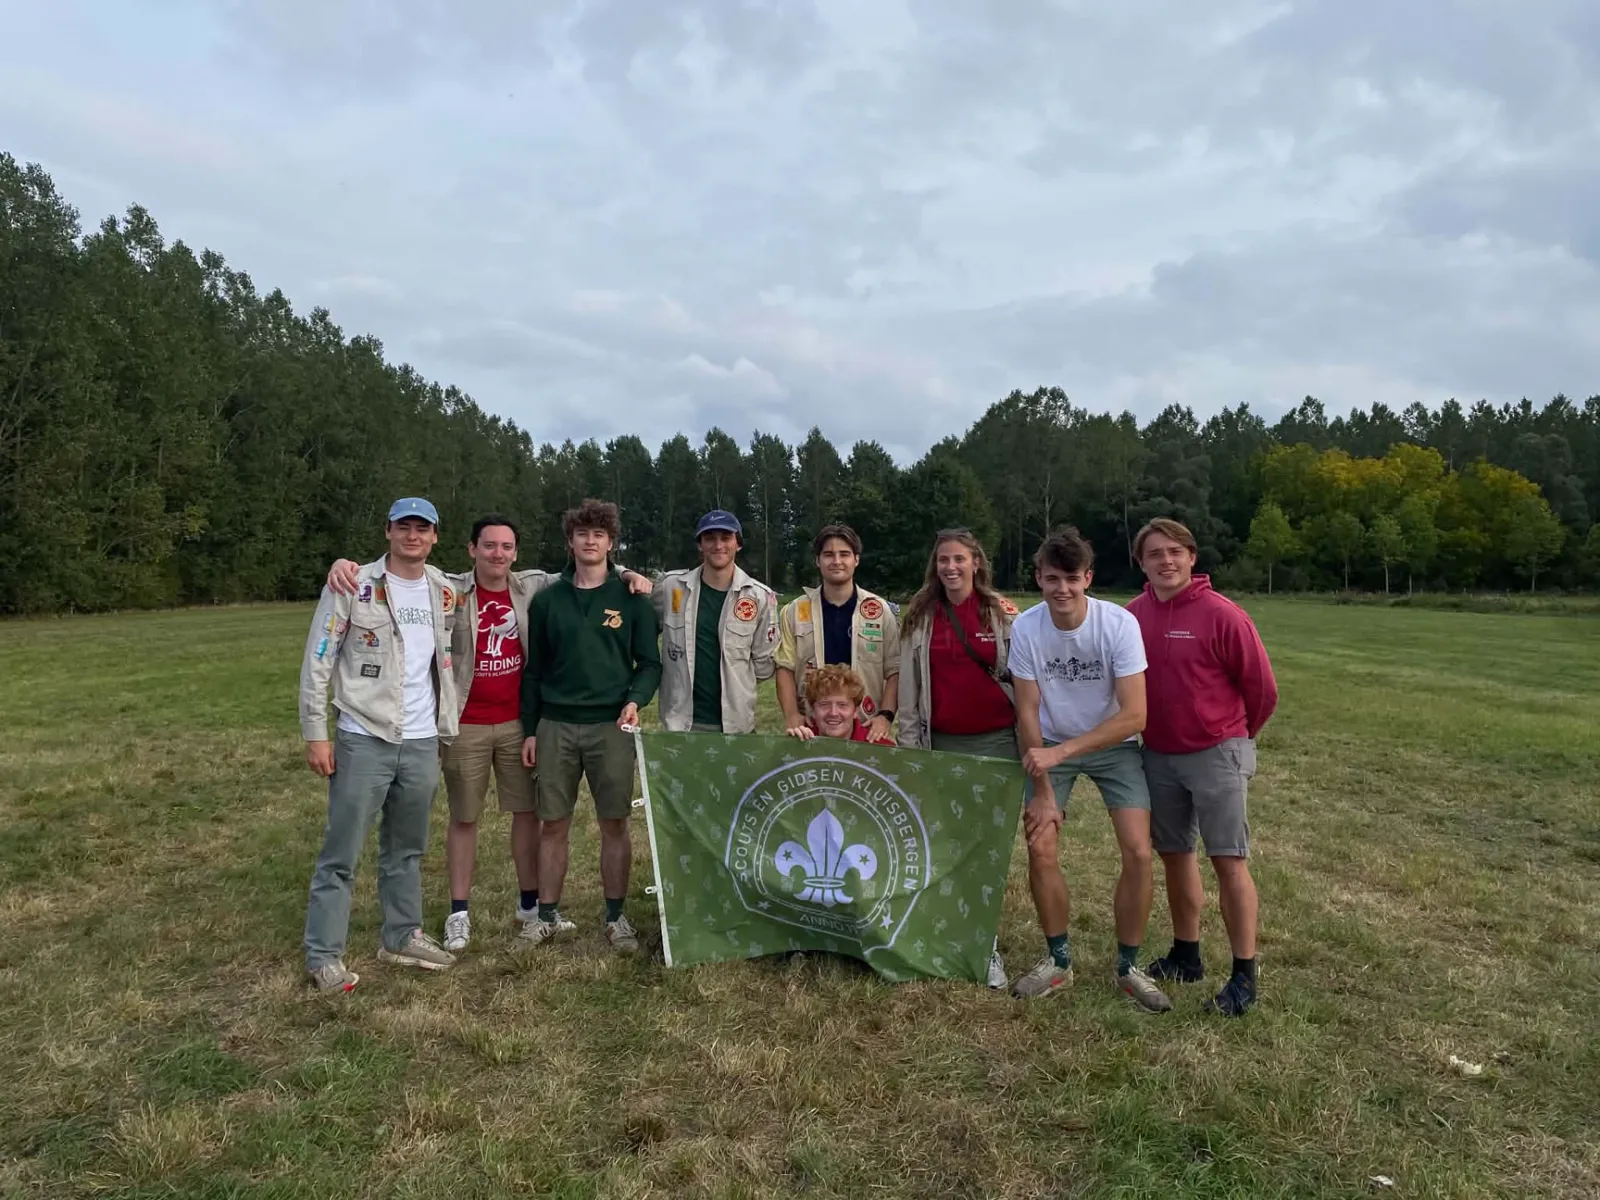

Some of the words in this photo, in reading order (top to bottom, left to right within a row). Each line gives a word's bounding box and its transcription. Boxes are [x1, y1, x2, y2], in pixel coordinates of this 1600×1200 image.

[474, 654, 521, 671] EIDING
[734, 812, 758, 882] SCOUTS
[752, 790, 774, 812] EN
[776, 768, 845, 794] GIDSEN
[851, 774, 919, 891] KLUISBERGEN
